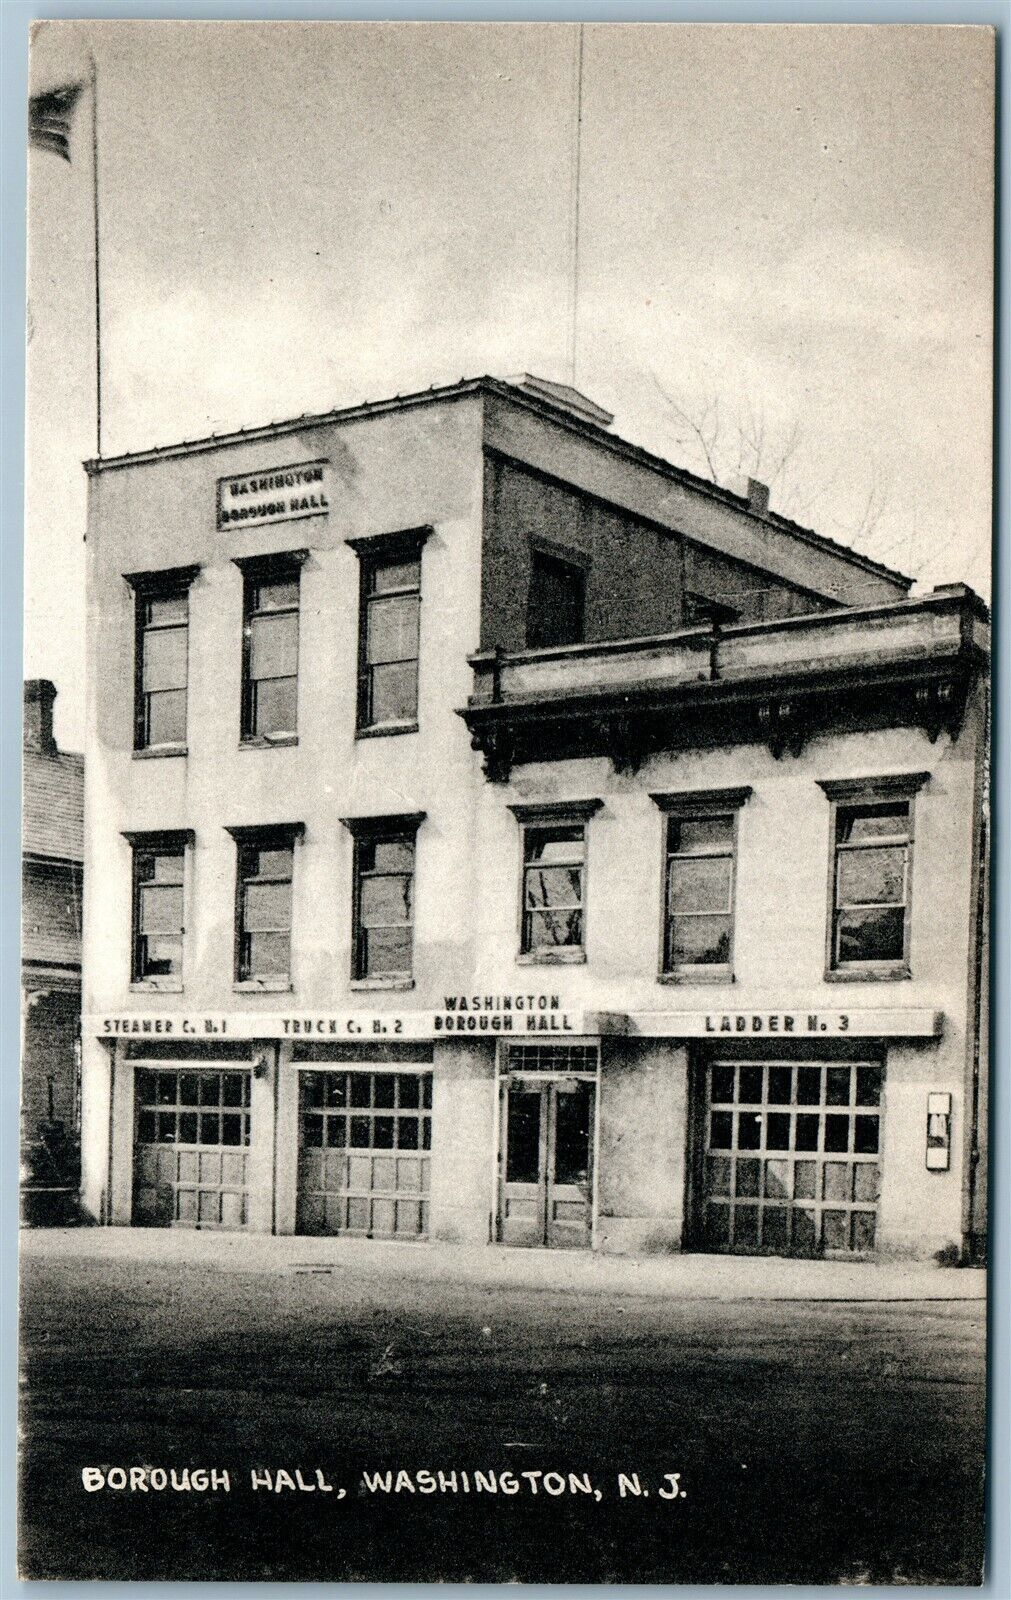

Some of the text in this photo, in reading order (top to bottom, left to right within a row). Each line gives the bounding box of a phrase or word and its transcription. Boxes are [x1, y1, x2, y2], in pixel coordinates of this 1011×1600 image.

[229, 467, 323, 496] WASHINGTON
[220, 494, 328, 523] BOROUGH HALL
[444, 995, 559, 1011] WASHINGTON
[103, 1020, 173, 1033] STEAMER
[282, 1020, 336, 1034] TRUCK
[394, 1019, 403, 1034] 2
[434, 1014, 572, 1031] BOROUGH HALL
[705, 1015, 795, 1032] LADDER
[838, 1015, 850, 1031] 3
